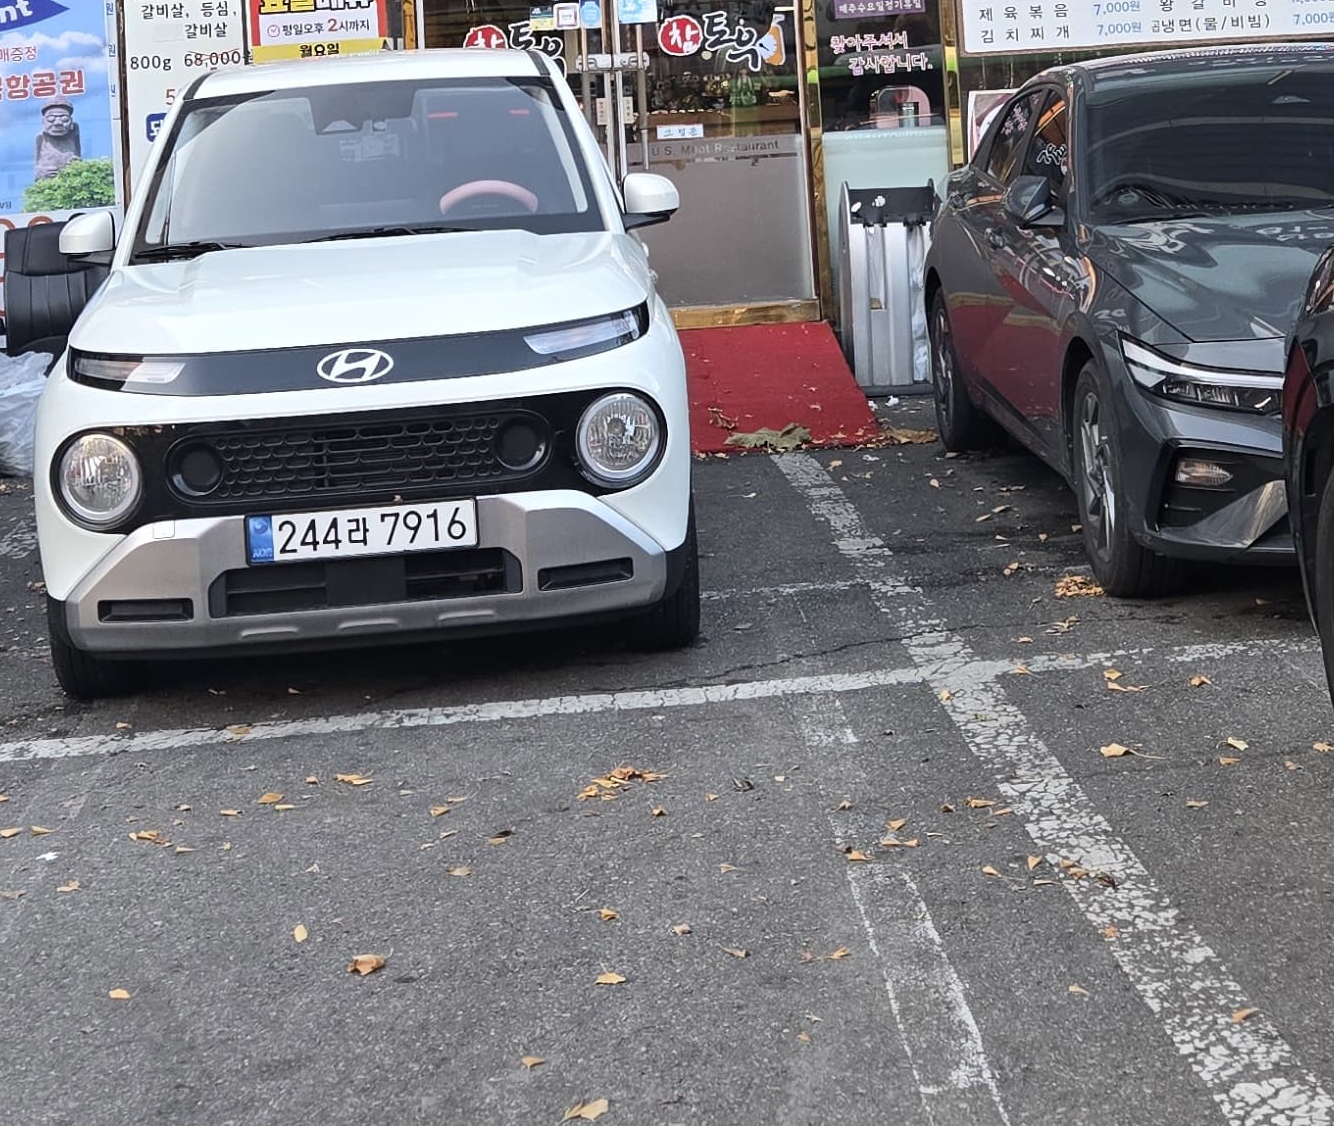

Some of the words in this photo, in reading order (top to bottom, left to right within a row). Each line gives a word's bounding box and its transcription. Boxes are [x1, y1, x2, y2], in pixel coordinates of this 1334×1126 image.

[1093, 1, 1140, 16] 7,000원
[185, 22, 227, 39] 갈비살
[282, 23, 324, 36] 평일오후
[1097, 22, 1142, 37] 7,000원
[299, 43, 340, 58] 월요일
[130, 54, 172, 71] 800g
[278, 517, 369, 555] 244라
[380, 507, 467, 545] 7916
